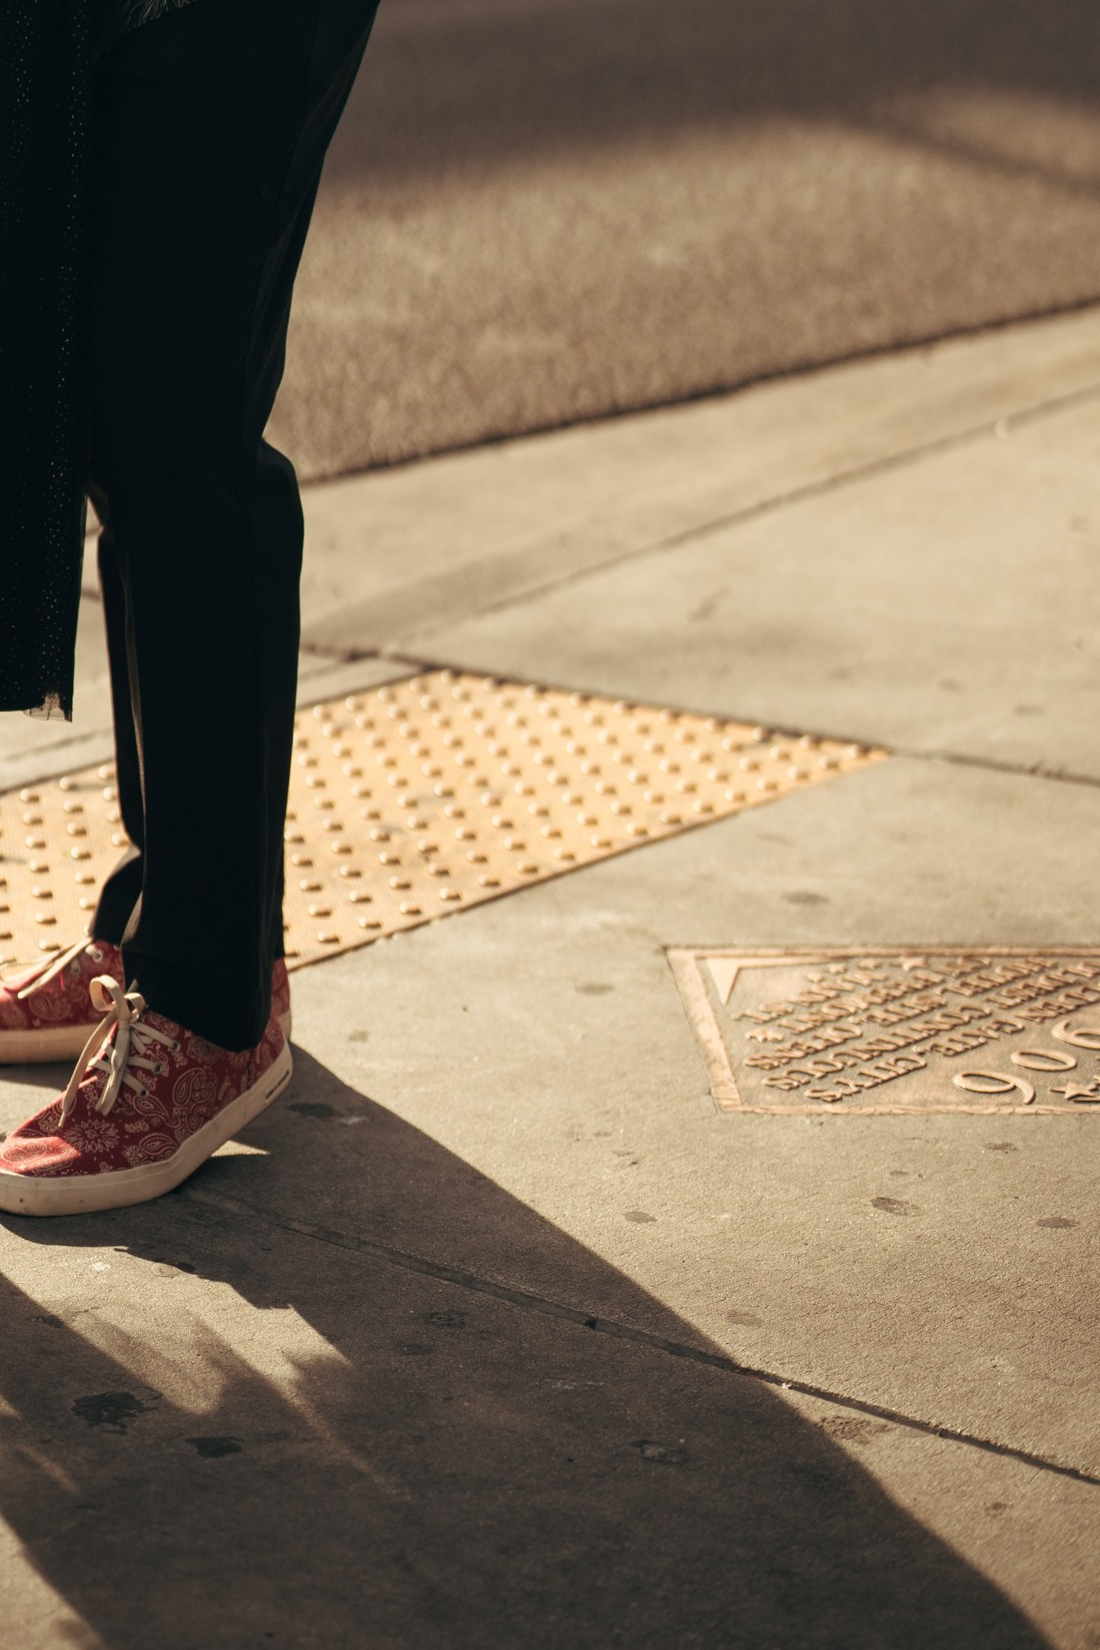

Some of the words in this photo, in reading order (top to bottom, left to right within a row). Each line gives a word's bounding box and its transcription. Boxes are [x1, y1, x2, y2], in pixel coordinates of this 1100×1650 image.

[934, 957, 1058, 998] HOTEL
[777, 972, 945, 1036] FREMONT
[744, 1025, 863, 1070] OPENS
[761, 1004, 992, 1091] CONTINUOUS
[912, 1019, 1025, 1057] GATE,
